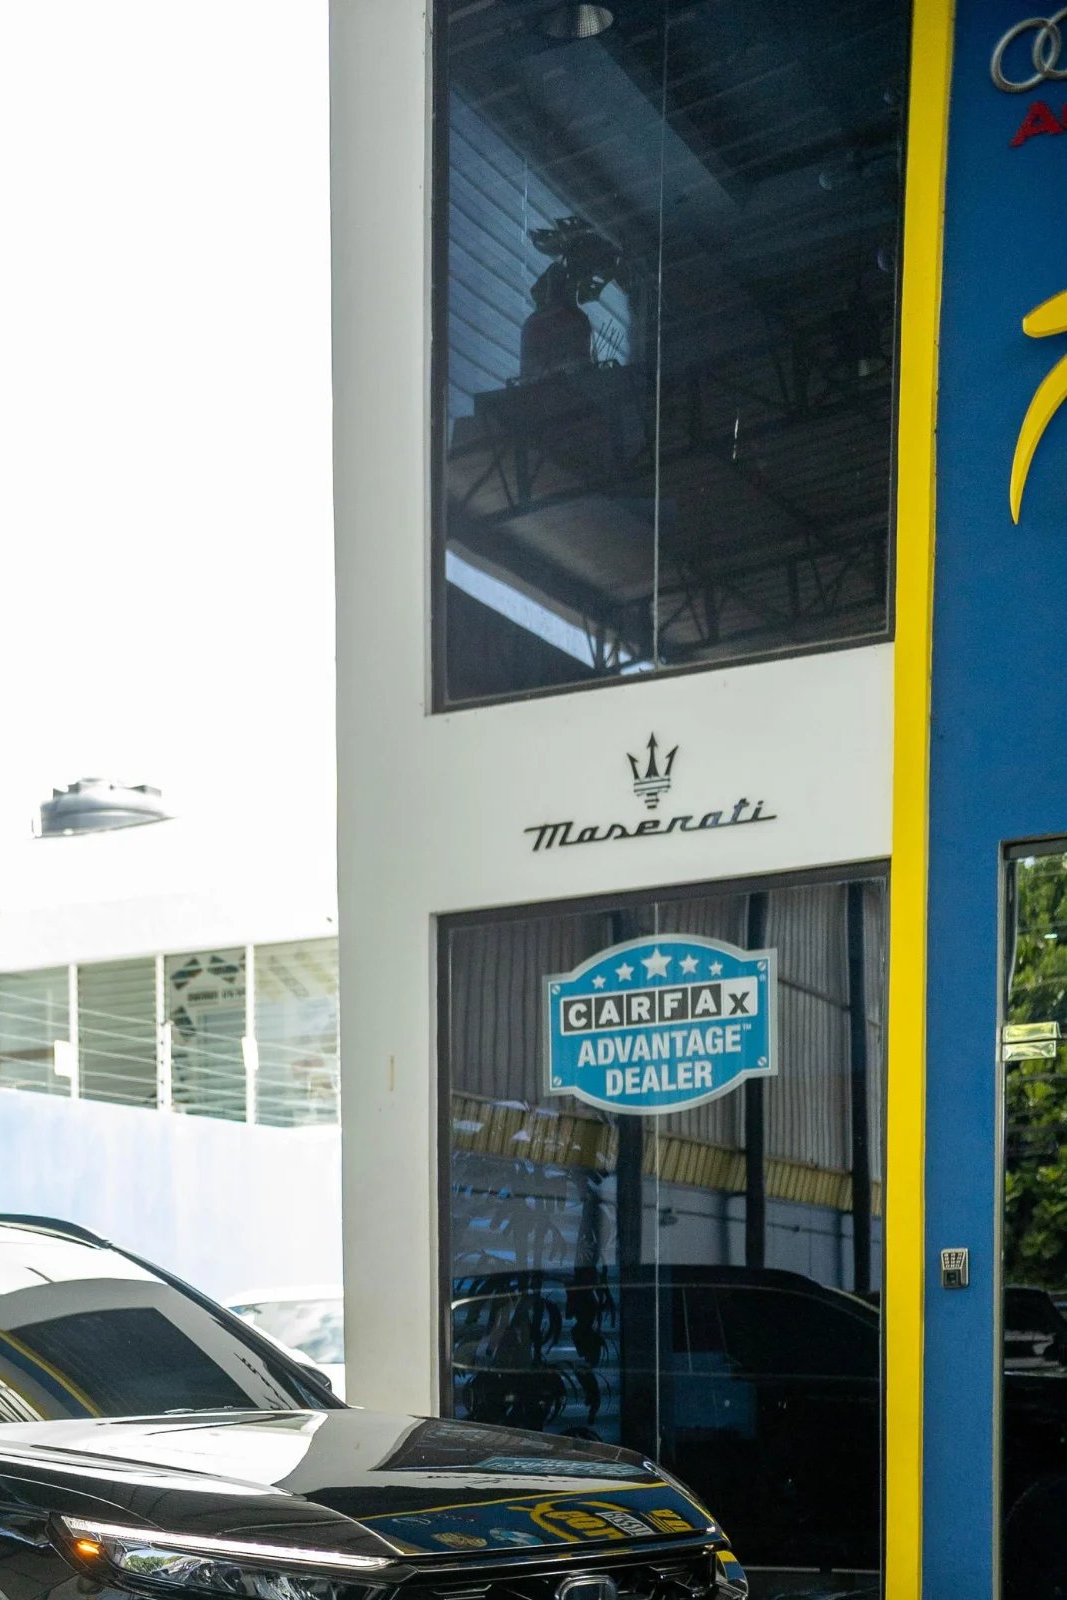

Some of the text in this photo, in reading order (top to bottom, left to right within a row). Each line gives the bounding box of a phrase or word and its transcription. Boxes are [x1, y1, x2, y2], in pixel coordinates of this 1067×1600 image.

[524, 798, 777, 851] Maserati
[567, 988, 750, 1028] CARFAX
[606, 1060, 713, 1097] DEALER
